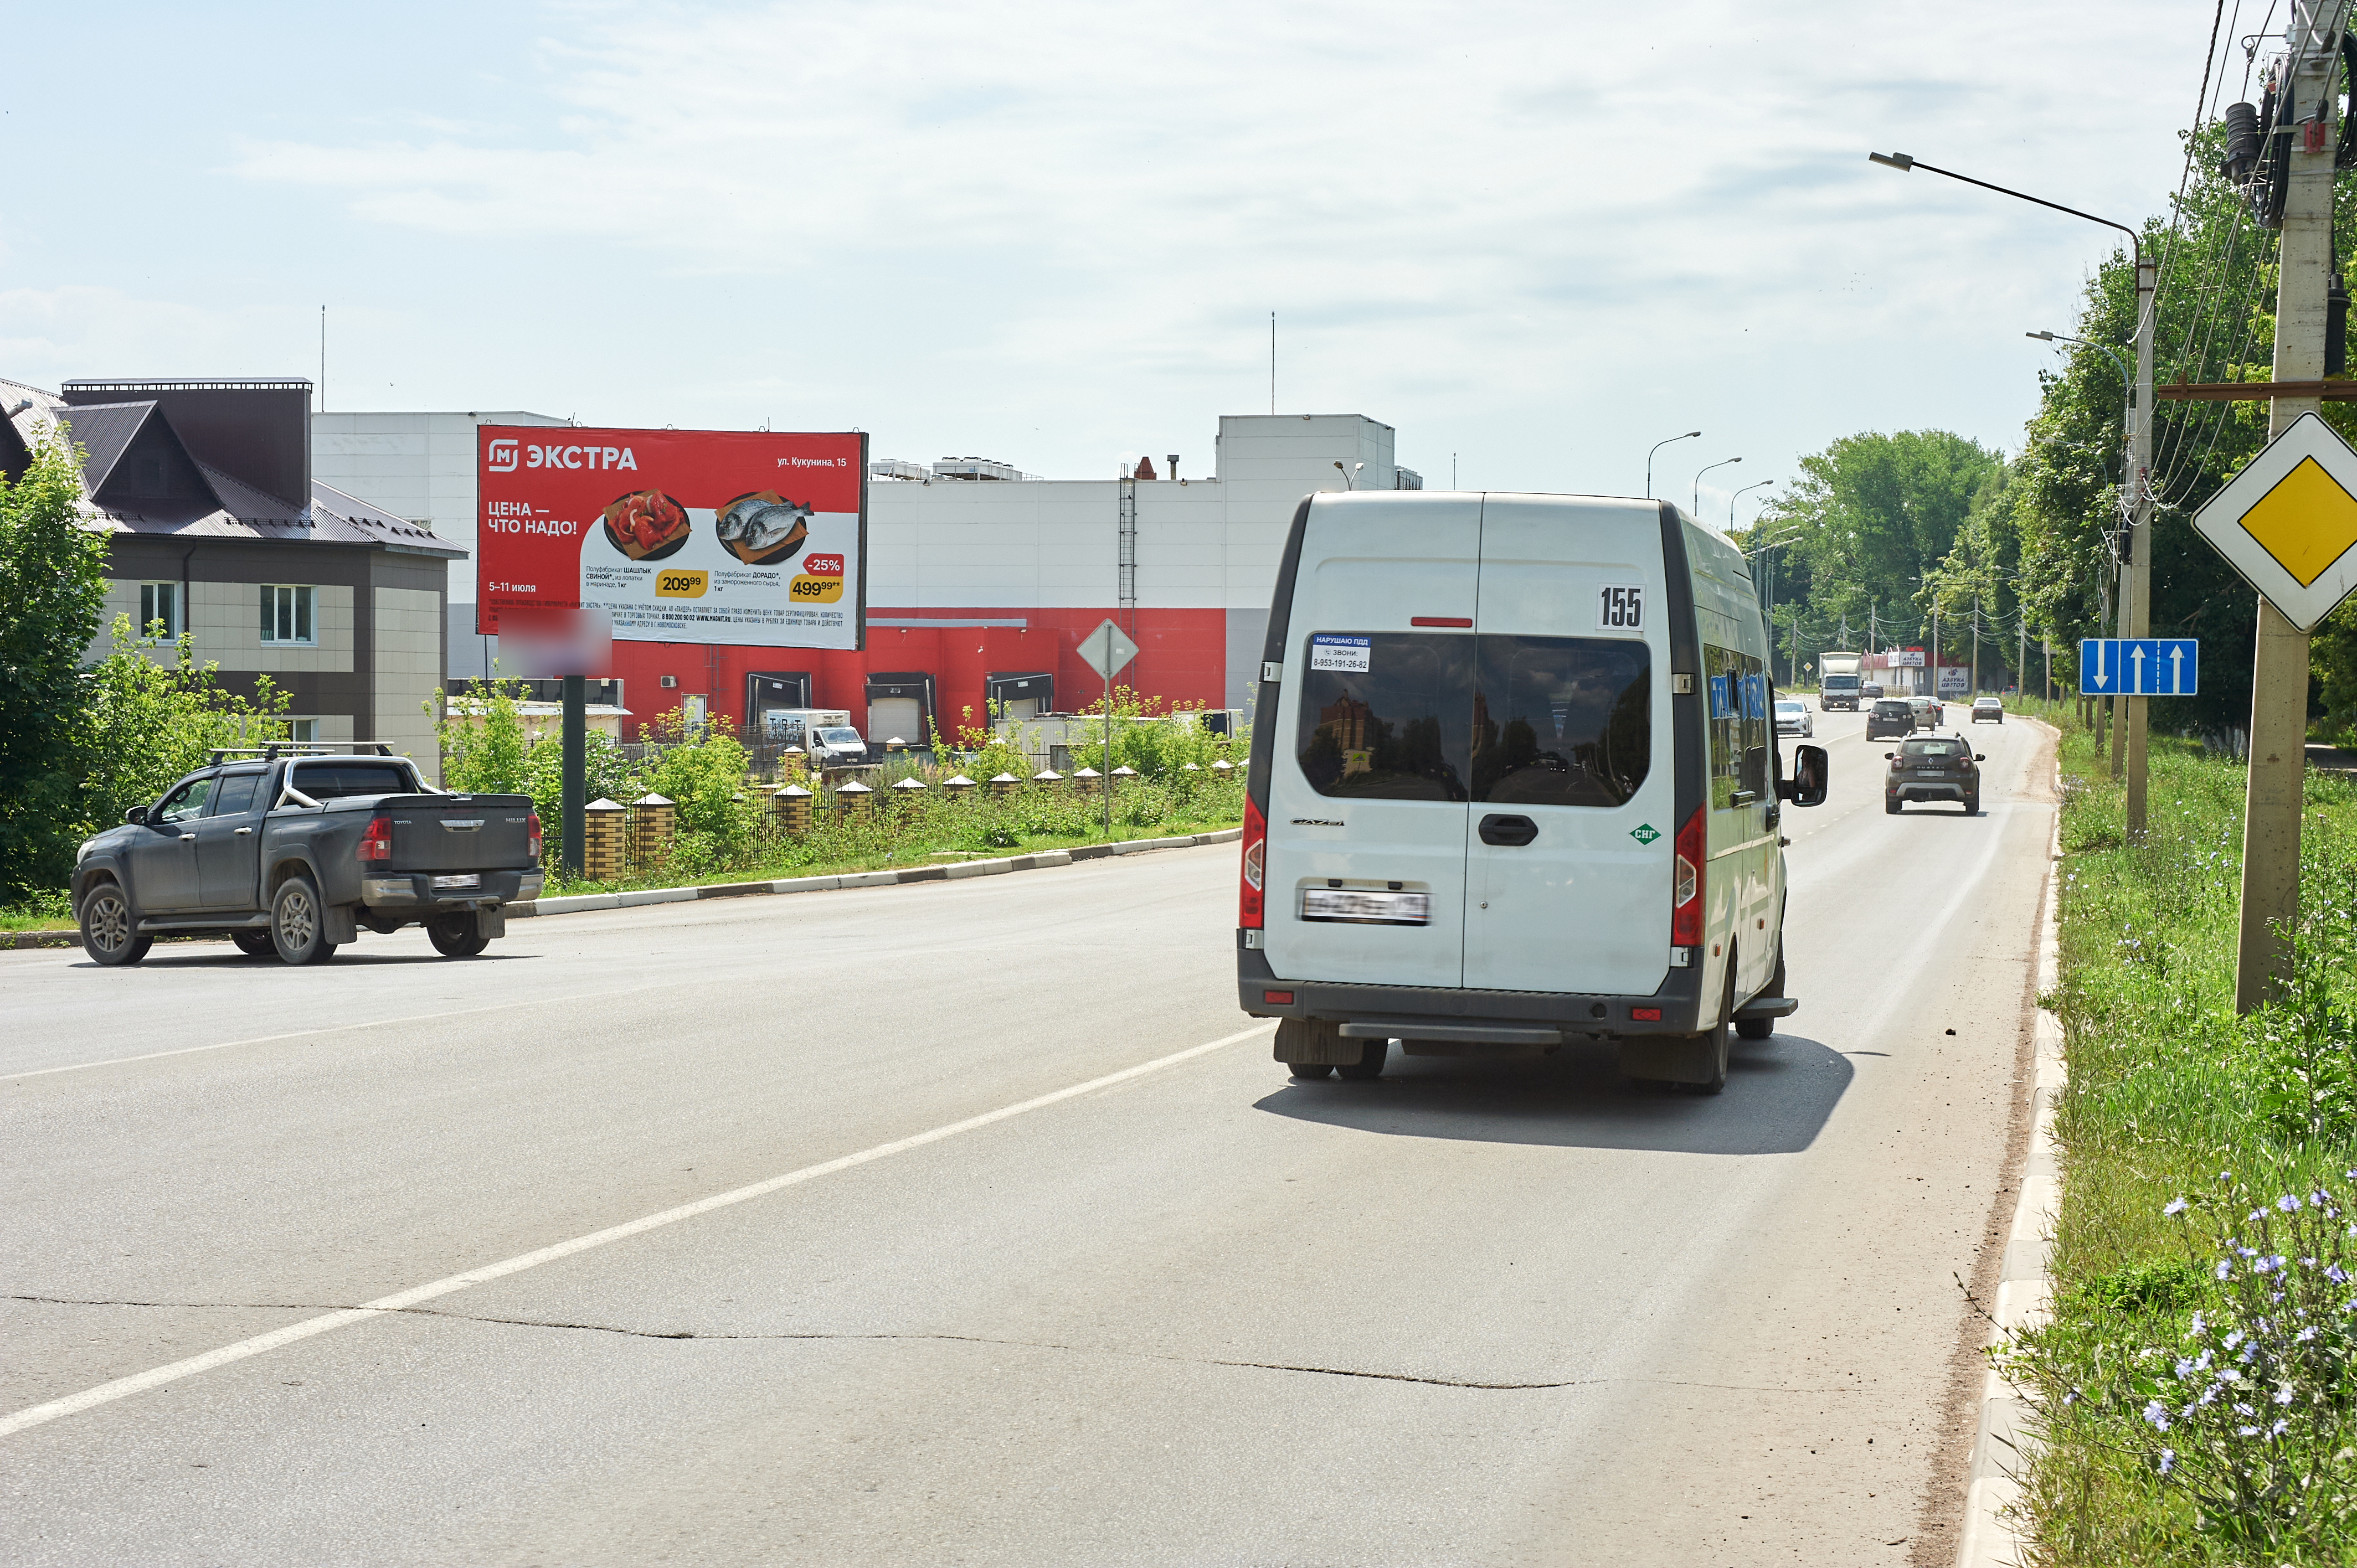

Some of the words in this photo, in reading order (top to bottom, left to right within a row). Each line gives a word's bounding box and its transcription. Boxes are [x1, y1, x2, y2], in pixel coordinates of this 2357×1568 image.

[527, 445, 637, 470] ЭКСТРА
[778, 458, 789, 467] ул.
[791, 457, 835, 468] Кукунина,
[837, 458, 846, 467] 15
[488, 502, 531, 517] ЦЕНА
[488, 519, 521, 533] ЧТО
[526, 520, 577, 537] НАДО!
[808, 559, 840, 571] -25%
[512, 584, 536, 592] июля
[1602, 587, 1641, 627] 155
[821, 619, 842, 627] ДЕЙСТВУЮТ
[1314, 658, 1367, 668] 8-953-191-26-82
[1635, 829, 1655, 839] СНГ
